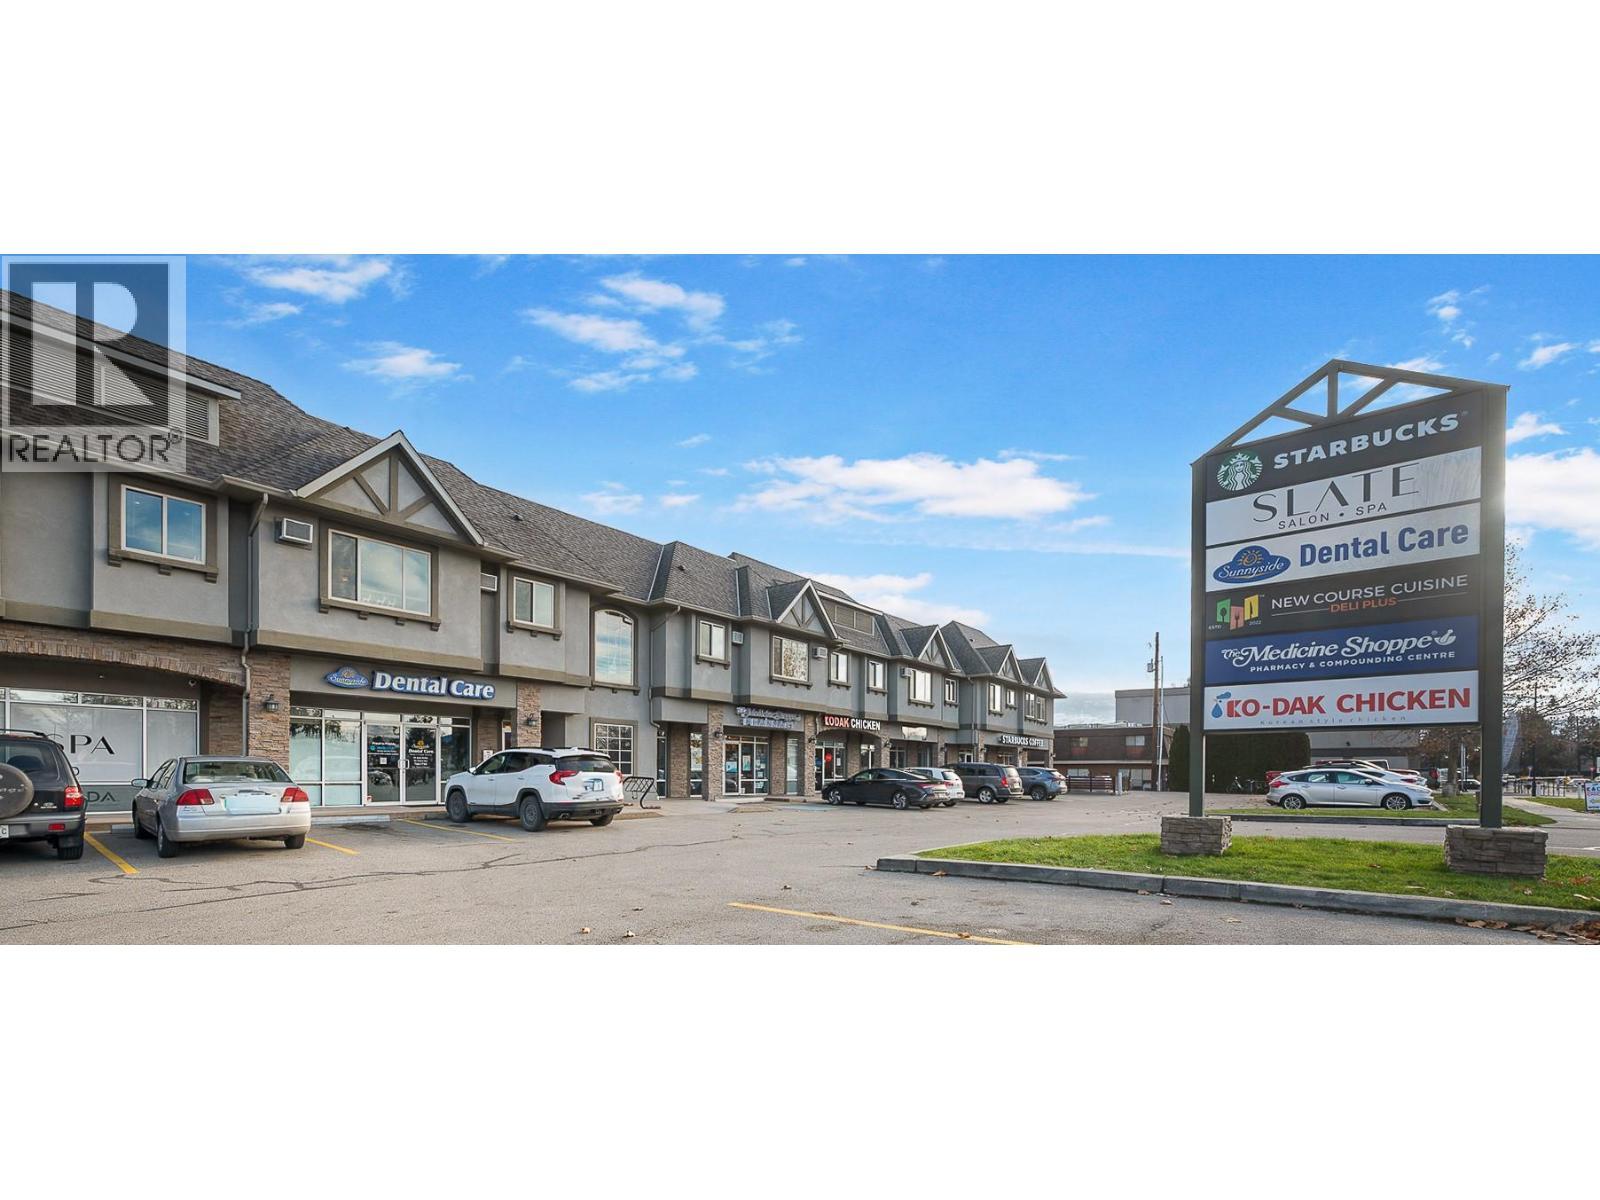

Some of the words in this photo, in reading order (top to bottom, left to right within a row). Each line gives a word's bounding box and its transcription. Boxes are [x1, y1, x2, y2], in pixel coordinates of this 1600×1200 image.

[1273, 413, 1459, 469] STARBUCKS
[1253, 462, 1419, 522] SLATE
[1278, 512, 1329, 530] SALON
[1355, 502, 1387, 516] SPA
[1300, 531, 1389, 567] Dental
[1398, 524, 1468, 552] Care
[1218, 558, 1285, 578] Sunnyside
[1271, 595, 1310, 609] NEW
[1313, 586, 1385, 604] COURSE
[1391, 574, 1468, 595] CUISINE
[1330, 601, 1360, 613] DELI
[1362, 597, 1398, 609] PLUS
[1232, 641, 1339, 667] Medicine
[1341, 636, 1432, 657] Shoppe
[1250, 662, 1305, 672] PHARMACY
[1320, 655, 1402, 667] COMPOUNDING
[1407, 651, 1455, 662] CENTRE
[374, 671, 448, 695] Dental
[449, 680, 495, 699] Care
[1227, 695, 1326, 718] KO-DAK
[1336, 687, 1471, 713] CHICKEN
[850, 719, 880, 731] CHICKEN
[46, 733, 115, 754] PA
